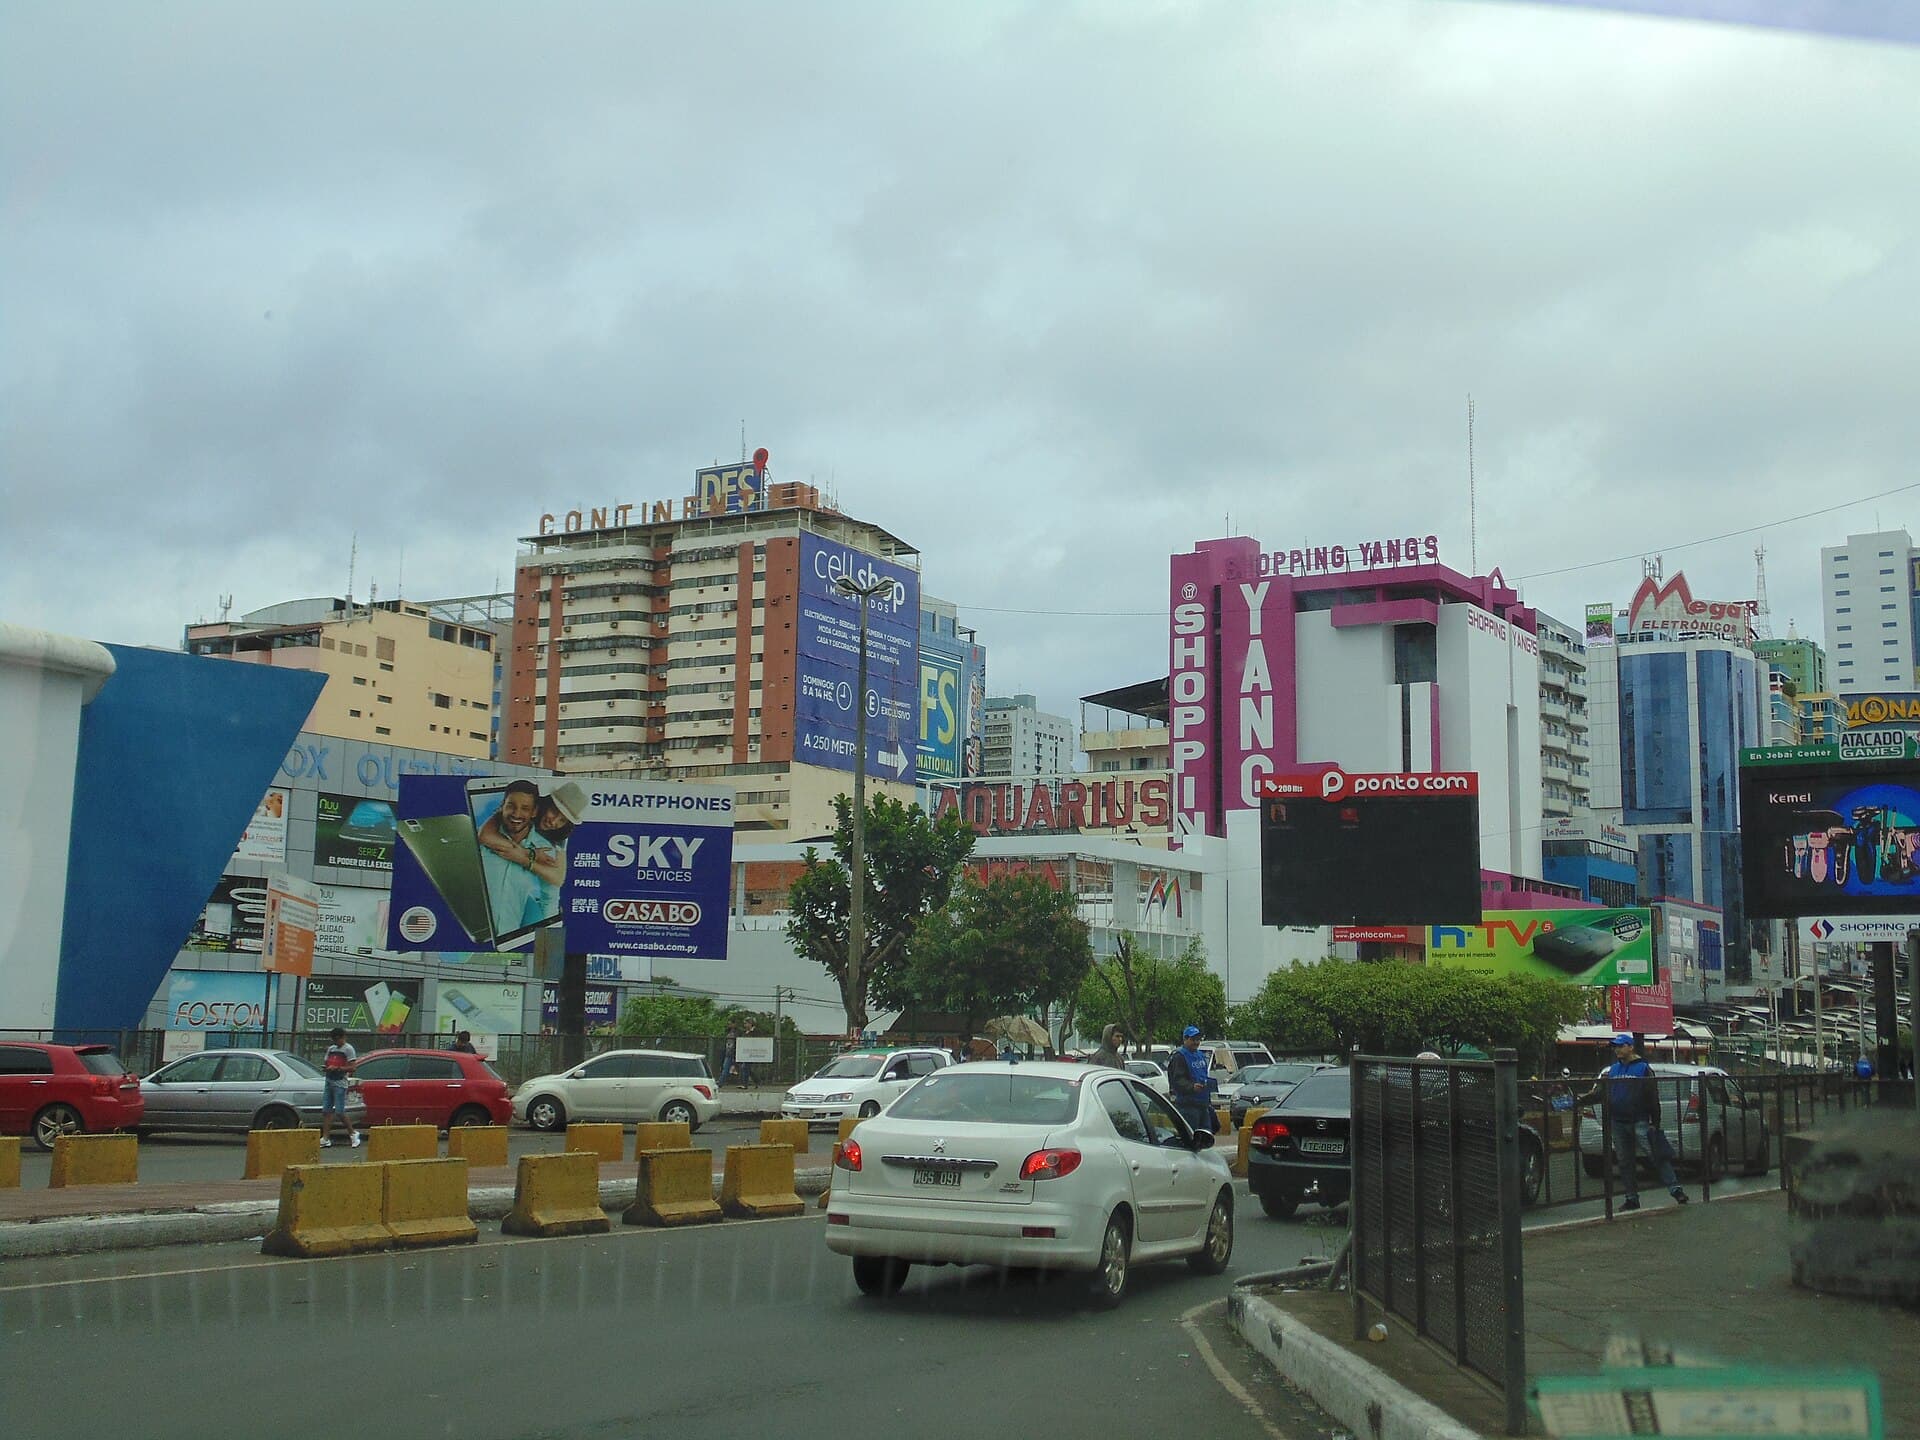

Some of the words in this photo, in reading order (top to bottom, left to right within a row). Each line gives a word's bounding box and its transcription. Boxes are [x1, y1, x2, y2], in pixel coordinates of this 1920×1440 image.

[1359, 535, 1439, 566] YANG'S
[1467, 608, 1506, 641] SHOPPING
[1641, 619, 1737, 635] ELETRÔNICOS
[1174, 602, 1206, 848] SHOPPIN
[804, 733, 811, 748] A
[813, 735, 830, 752] 250
[1841, 731, 1903, 747] ATACADO
[1750, 753, 1762, 761] En
[1797, 749, 1832, 758] Center
[1842, 747, 1901, 757] GAMES
[916, 752, 955, 775] NATIONAL
[1354, 776, 1420, 794] ponto
[1423, 776, 1469, 790] com
[591, 793, 731, 812] SMARTPHONES
[935, 779, 1169, 836] AQUARIUS
[606, 834, 705, 870] SKY
[329, 856, 337, 864] EL
[337, 857, 357, 867] PODER
[358, 859, 366, 867] DE
[367, 860, 375, 868] LA
[574, 860, 601, 868] CENTER
[574, 879, 601, 888] PARIS
[637, 870, 692, 882] DEVICES
[571, 905, 599, 913] ESTE
[606, 902, 666, 923] CASA
[668, 904, 698, 923] BO
[325, 914, 356, 923] PRIMERA
[1840, 922, 1905, 932] SHOPPING
[608, 942, 698, 953] www.casabo.com.py
[175, 1001, 265, 1027] FOSTON
[306, 1007, 350, 1024] SERIE
[350, 1002, 370, 1028] A
